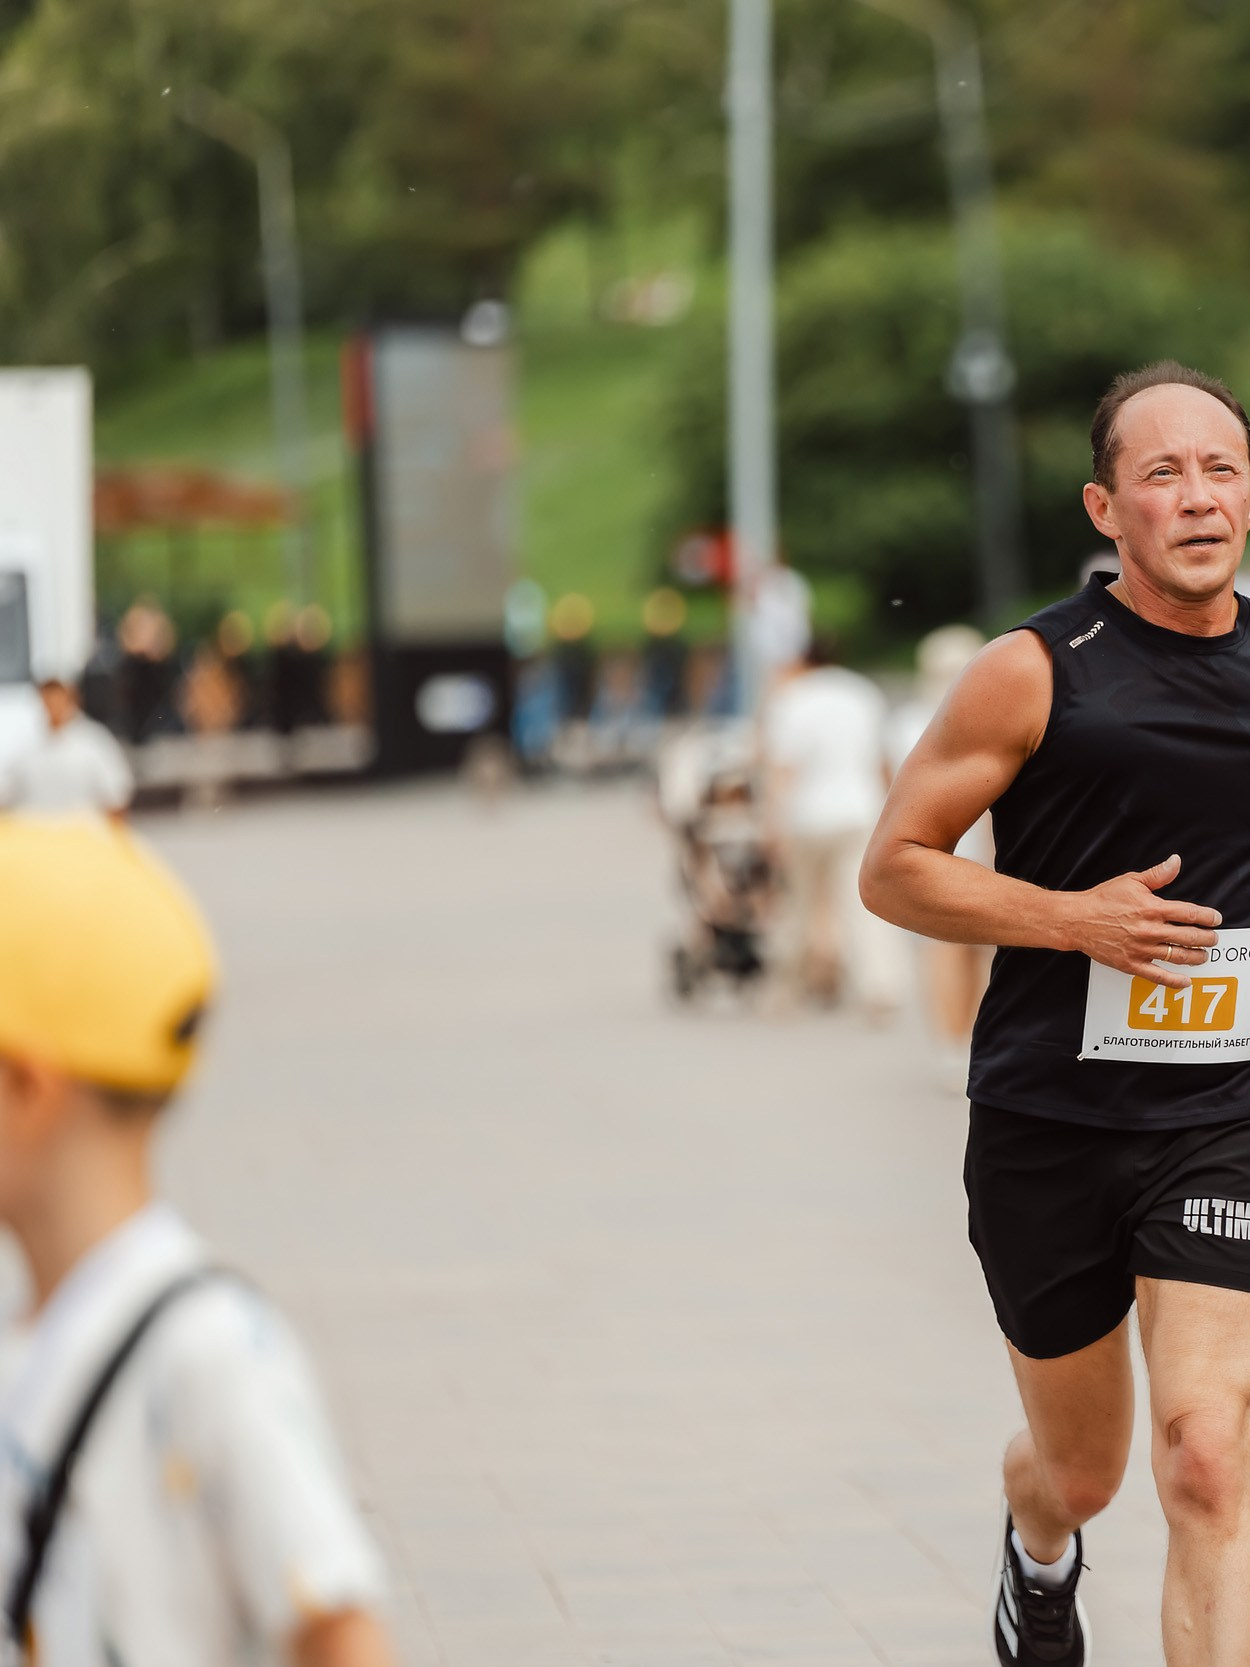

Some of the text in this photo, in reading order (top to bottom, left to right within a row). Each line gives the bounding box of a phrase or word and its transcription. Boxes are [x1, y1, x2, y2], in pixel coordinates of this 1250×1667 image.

[1139, 984, 1228, 1024] 417
[1103, 1036, 1250, 1048] БЛАГОТВОРИТЕЛЬНЫЙ ЗАБЕГ
